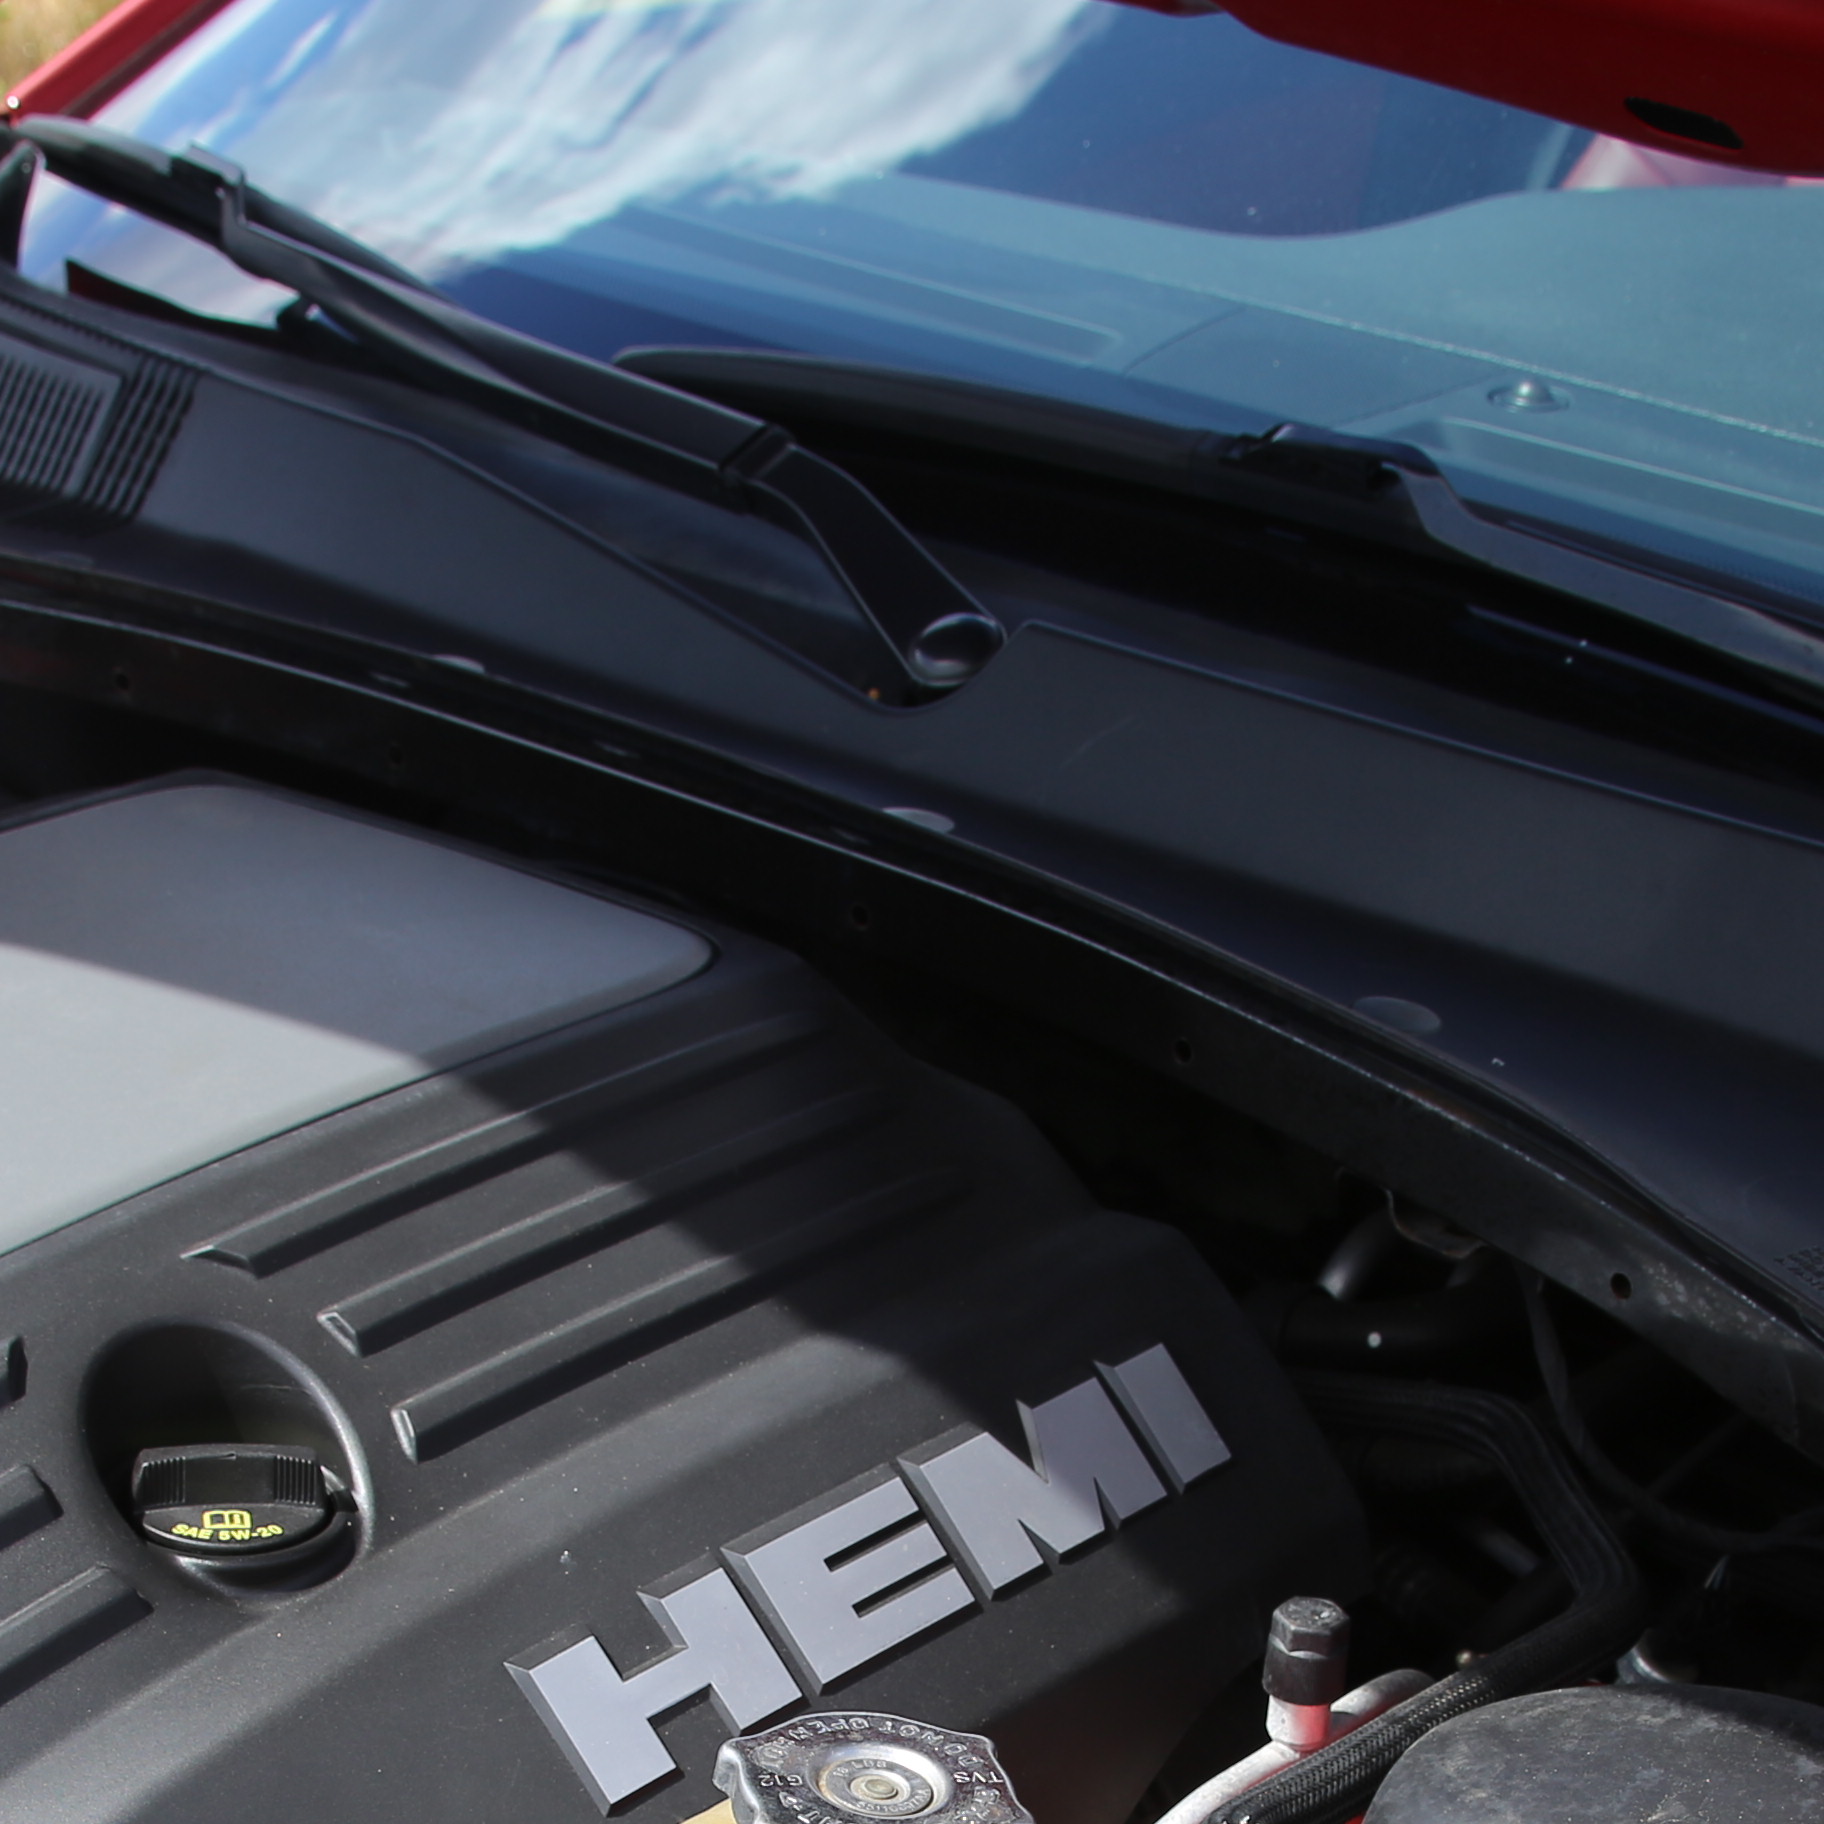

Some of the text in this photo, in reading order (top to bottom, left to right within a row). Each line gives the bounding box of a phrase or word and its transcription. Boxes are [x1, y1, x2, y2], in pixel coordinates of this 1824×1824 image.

[171, 1522, 284, 1541] SAE 5W-20
[503, 1342, 1233, 1817] HEMI
[757, 1774, 803, 1786] G12
[953, 1771, 1004, 1783] TVS
